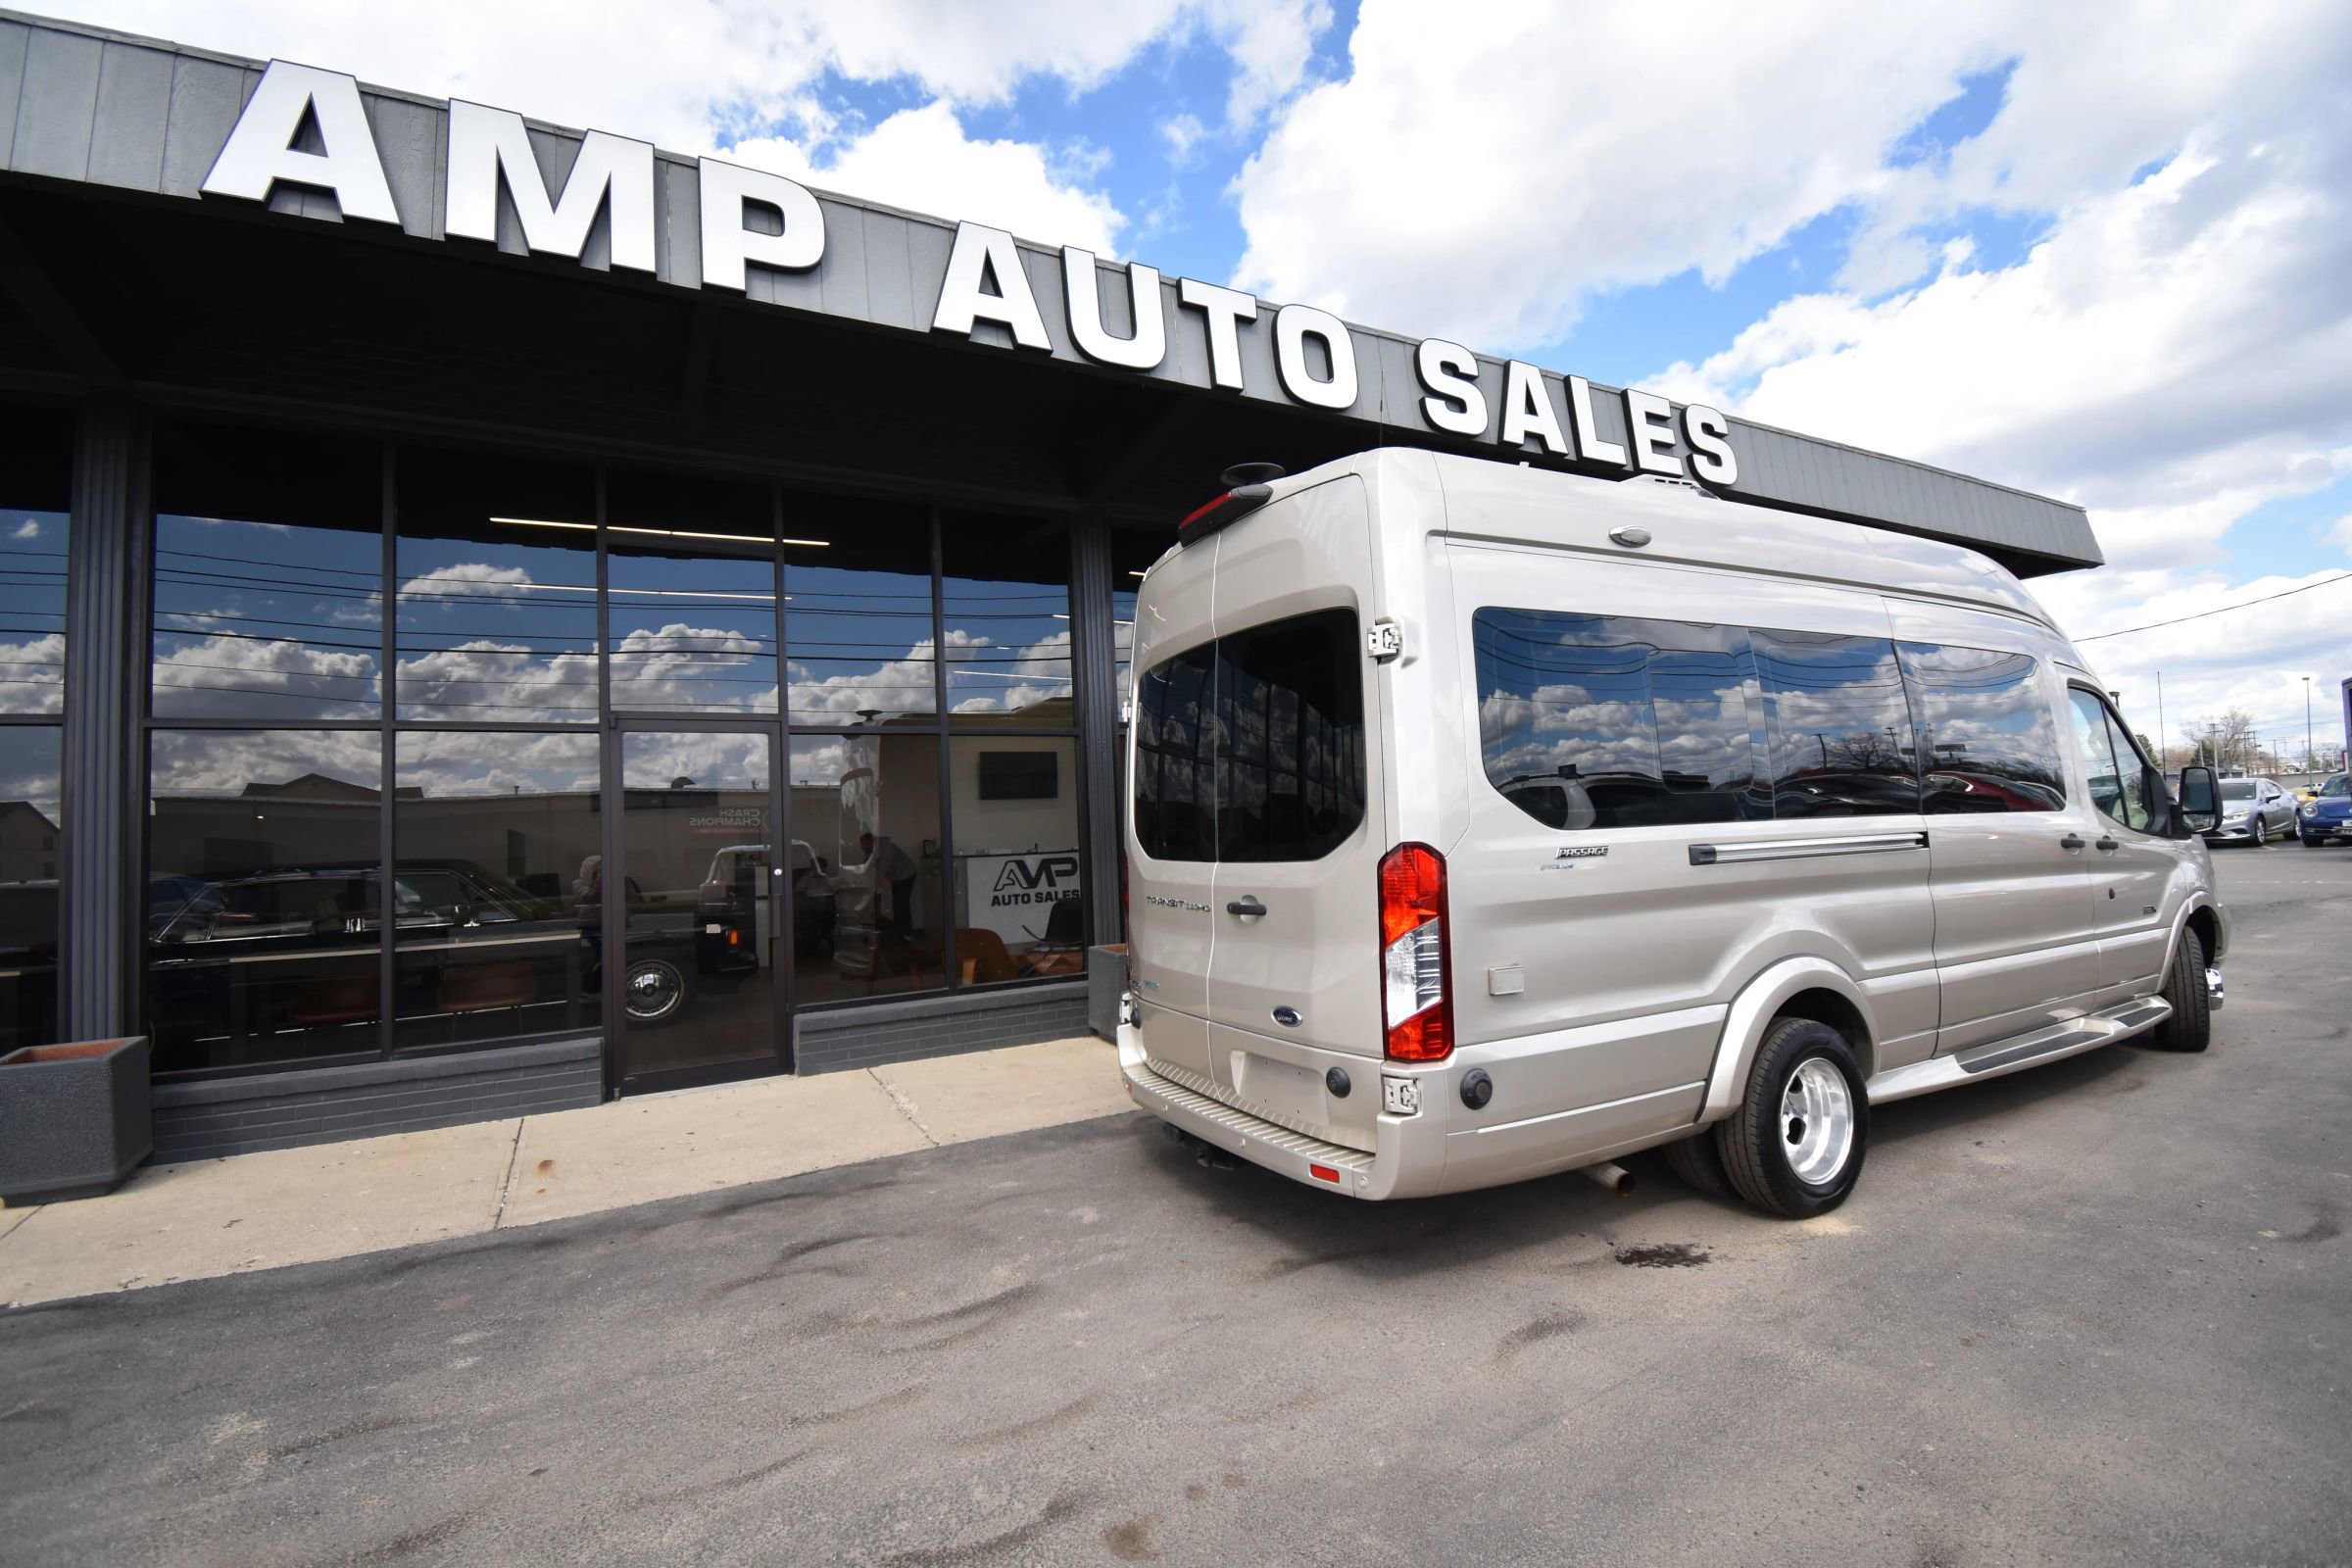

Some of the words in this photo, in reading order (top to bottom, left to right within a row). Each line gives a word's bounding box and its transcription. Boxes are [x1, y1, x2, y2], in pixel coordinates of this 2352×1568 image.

[199, 58, 826, 291] AMP
[930, 220, 1358, 410] AUTO
[1416, 338, 1739, 486] SALES
[1558, 846, 1609, 858] PASSAGE
[991, 893, 1031, 907] AUTO
[1035, 890, 1080, 904] SALES
[1146, 896, 1185, 908] TRANSIT
